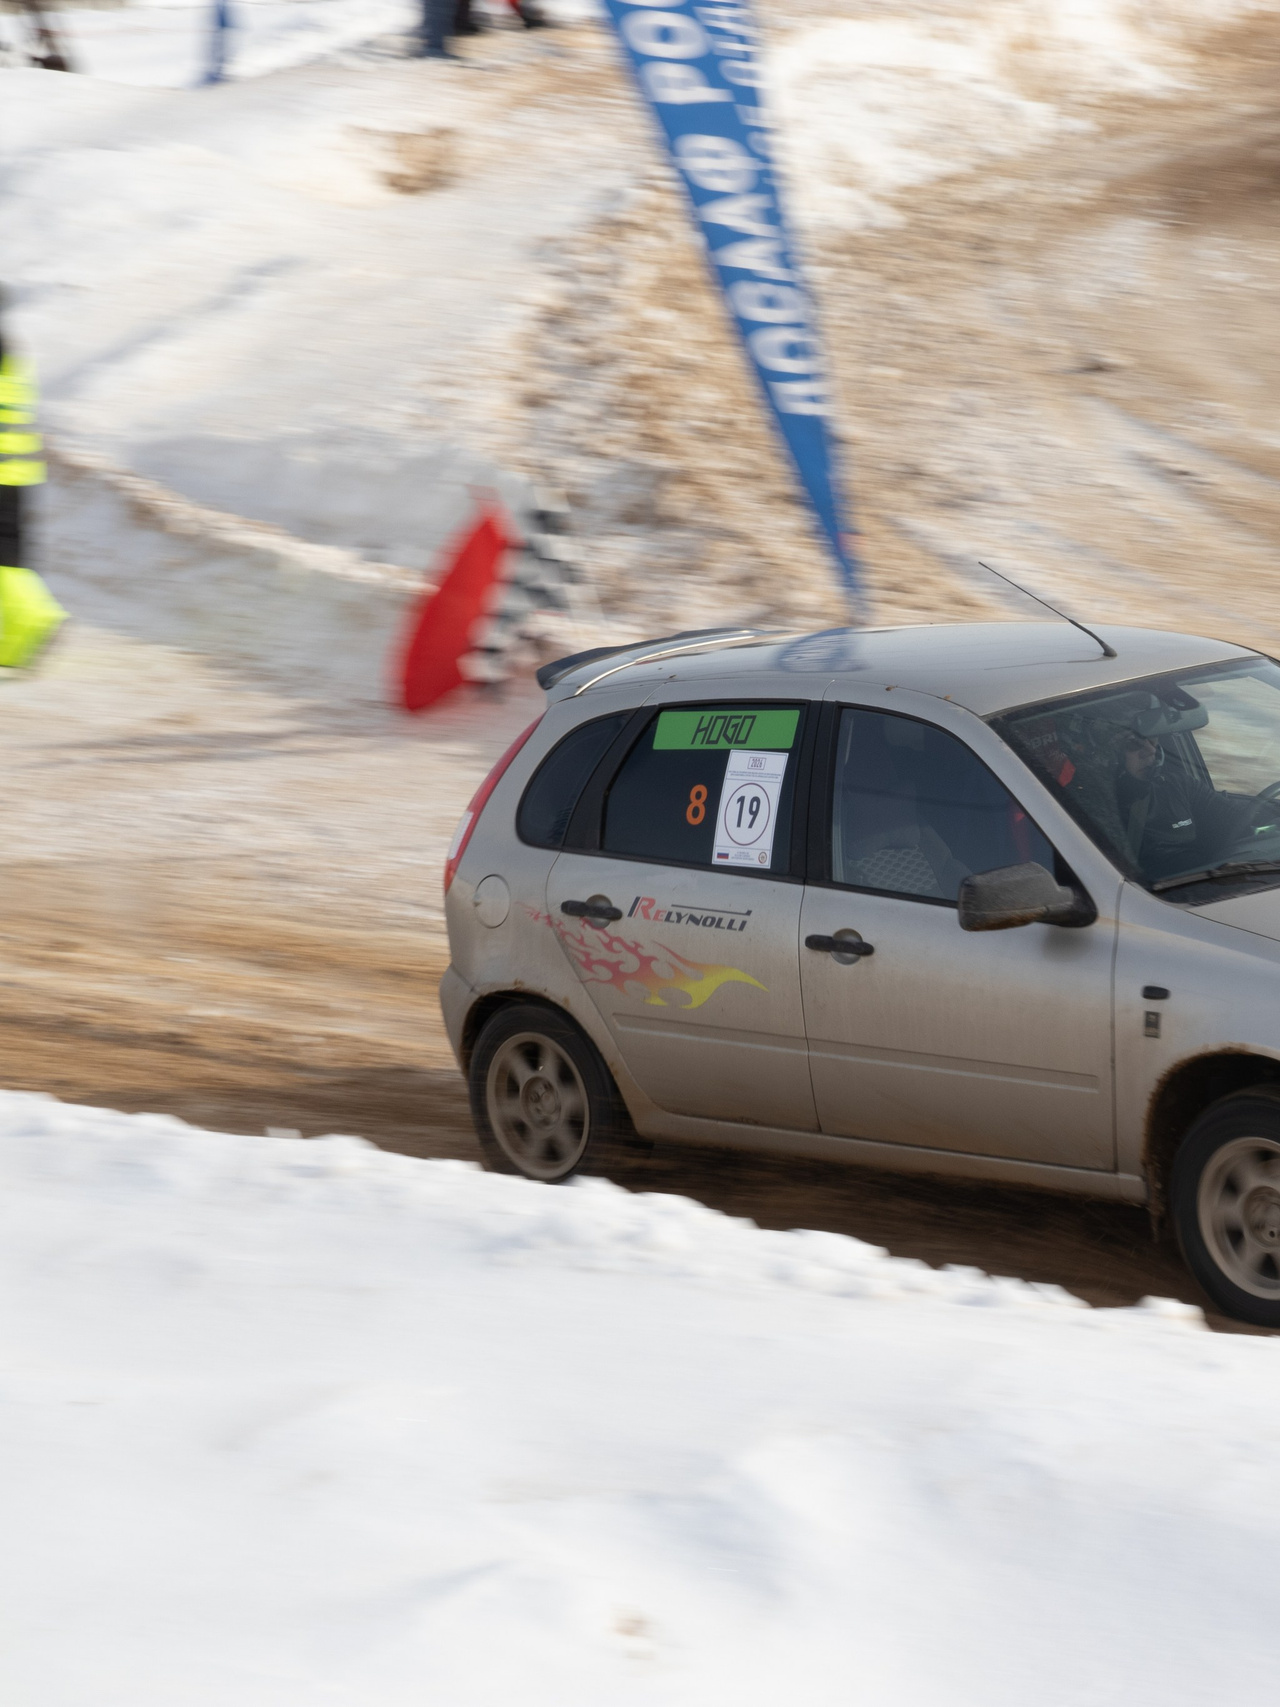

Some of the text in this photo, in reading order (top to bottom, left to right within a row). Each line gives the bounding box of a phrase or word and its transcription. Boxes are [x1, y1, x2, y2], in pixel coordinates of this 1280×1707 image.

[615, 0, 737, 106] РО
[690, 714, 757, 745] HOGO
[686, 784, 708, 825] 8
[736, 795, 761, 829] 19
